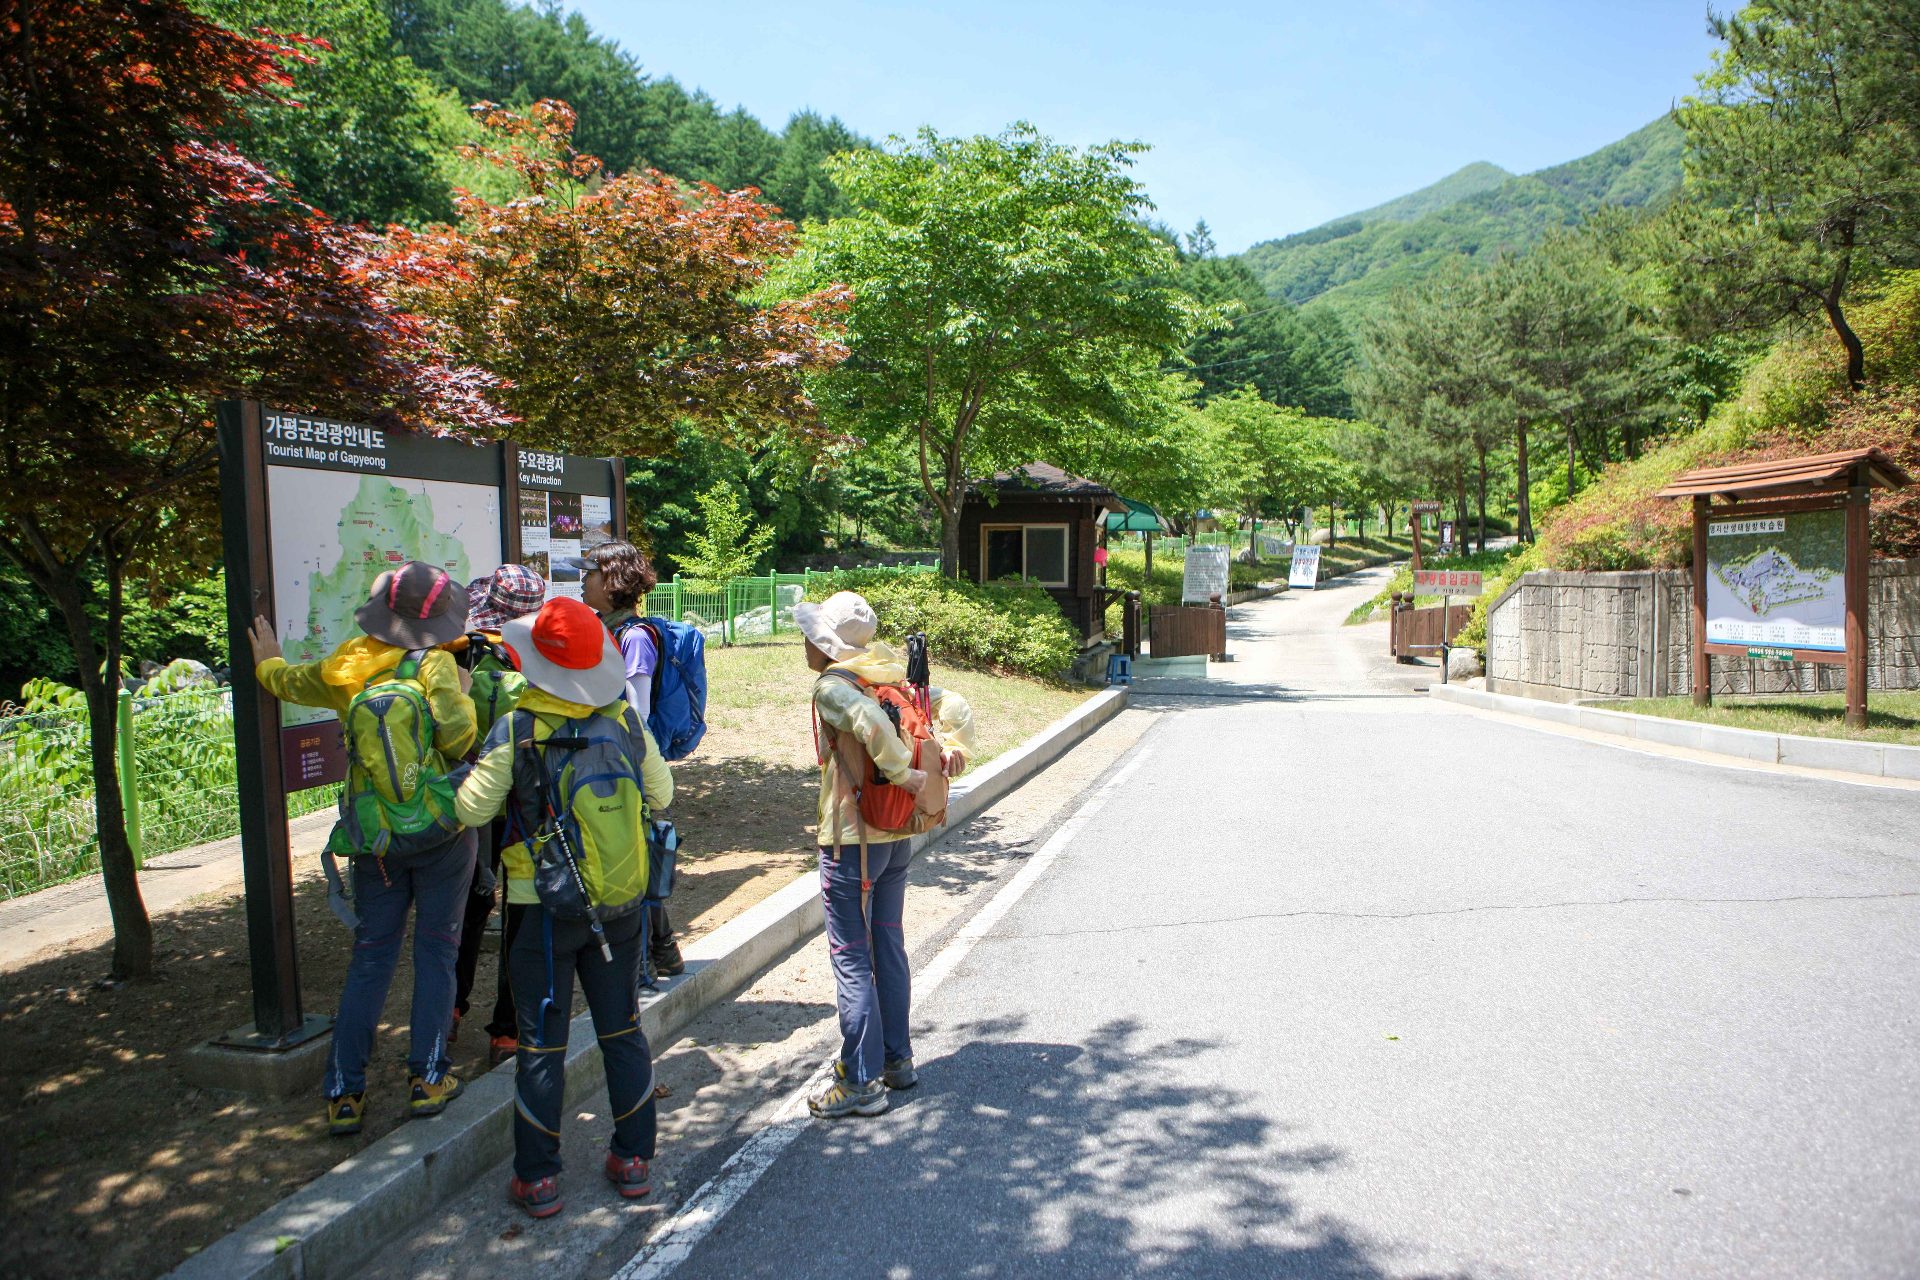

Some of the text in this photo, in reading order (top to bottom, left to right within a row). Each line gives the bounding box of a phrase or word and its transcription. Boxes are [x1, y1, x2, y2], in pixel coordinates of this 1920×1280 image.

[266, 415, 386, 449] 가평군관광안내도
[266, 442, 386, 470] Tourist Map of Gapyeong
[518, 450, 564, 474] 주요관광지
[531, 473, 562, 486] Attraction
